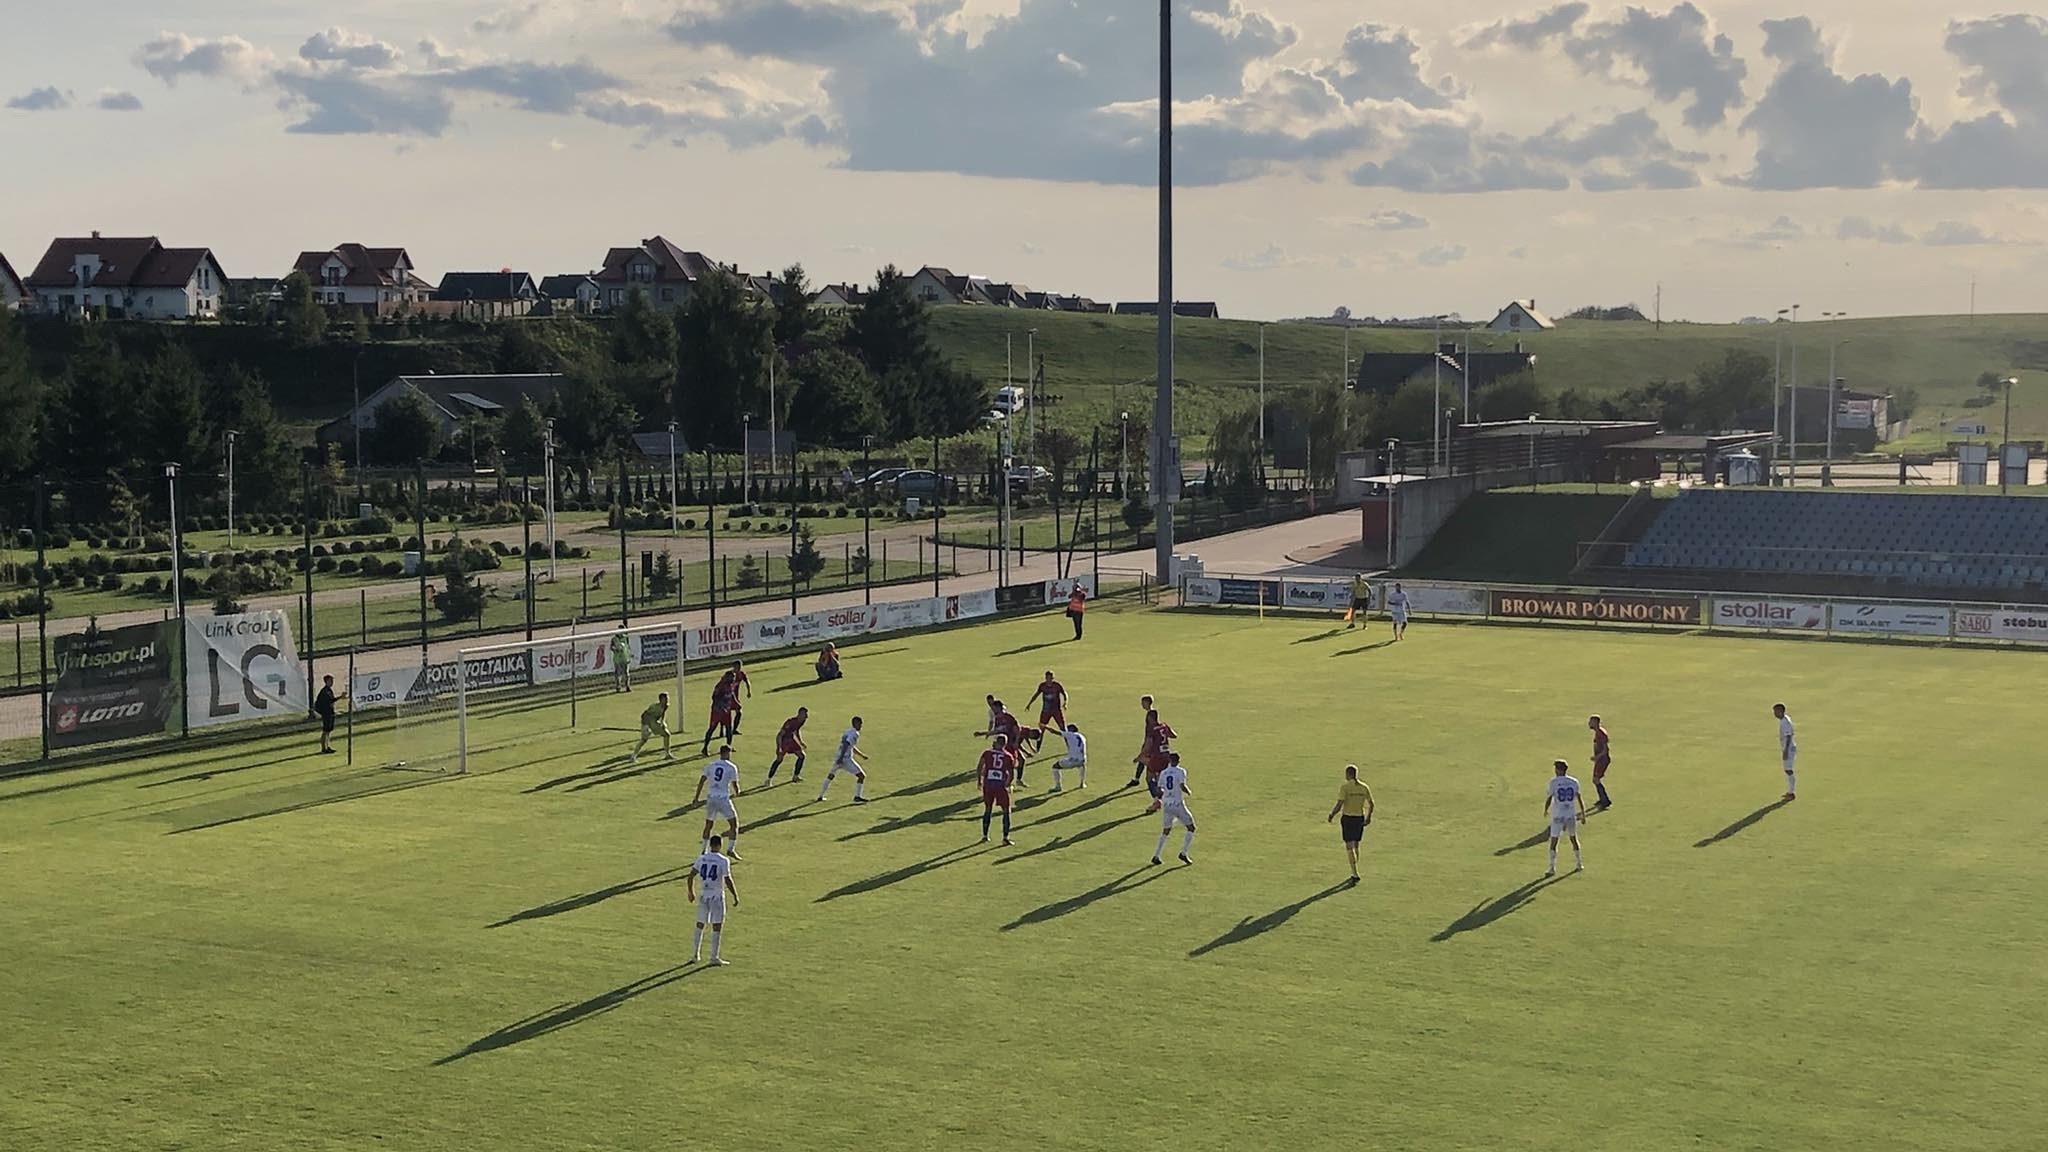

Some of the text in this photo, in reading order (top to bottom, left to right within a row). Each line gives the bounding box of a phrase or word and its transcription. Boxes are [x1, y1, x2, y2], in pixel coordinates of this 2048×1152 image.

[1501, 598, 1690, 622] BROWAR PÓŁNOCNY
[1720, 602, 1796, 619] stollar
[828, 610, 866, 628] stollar
[2003, 616, 2047, 629] stobu
[205, 622, 233, 638] Link
[698, 623, 744, 645] MIRAGE
[80, 702, 144, 723] LOTTO
[992, 753, 1005, 769] 15
[714, 767, 724, 782] 9
[1166, 775, 1174, 790] 8
[700, 863, 718, 881] 44
